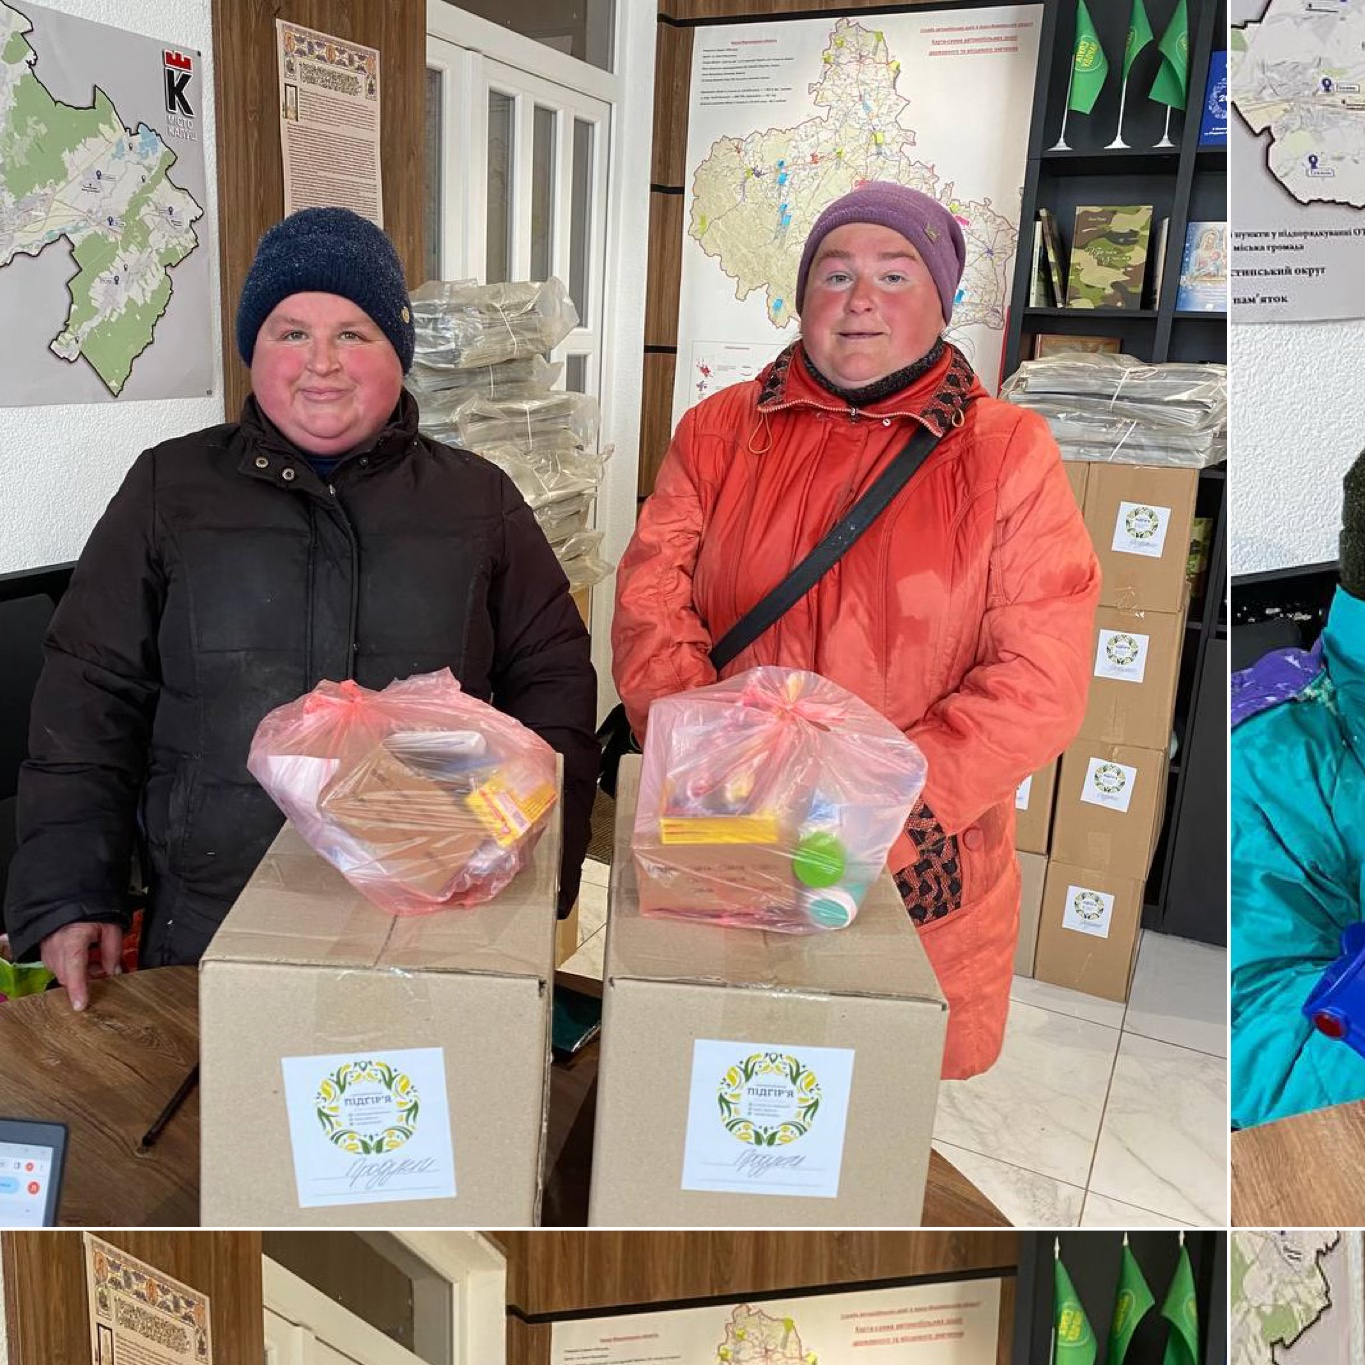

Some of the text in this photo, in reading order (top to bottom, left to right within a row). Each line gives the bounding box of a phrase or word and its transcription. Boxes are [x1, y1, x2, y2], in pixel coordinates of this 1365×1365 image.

[1233, 243, 1305, 254] міська громада
[1294, 266, 1327, 278] округ
